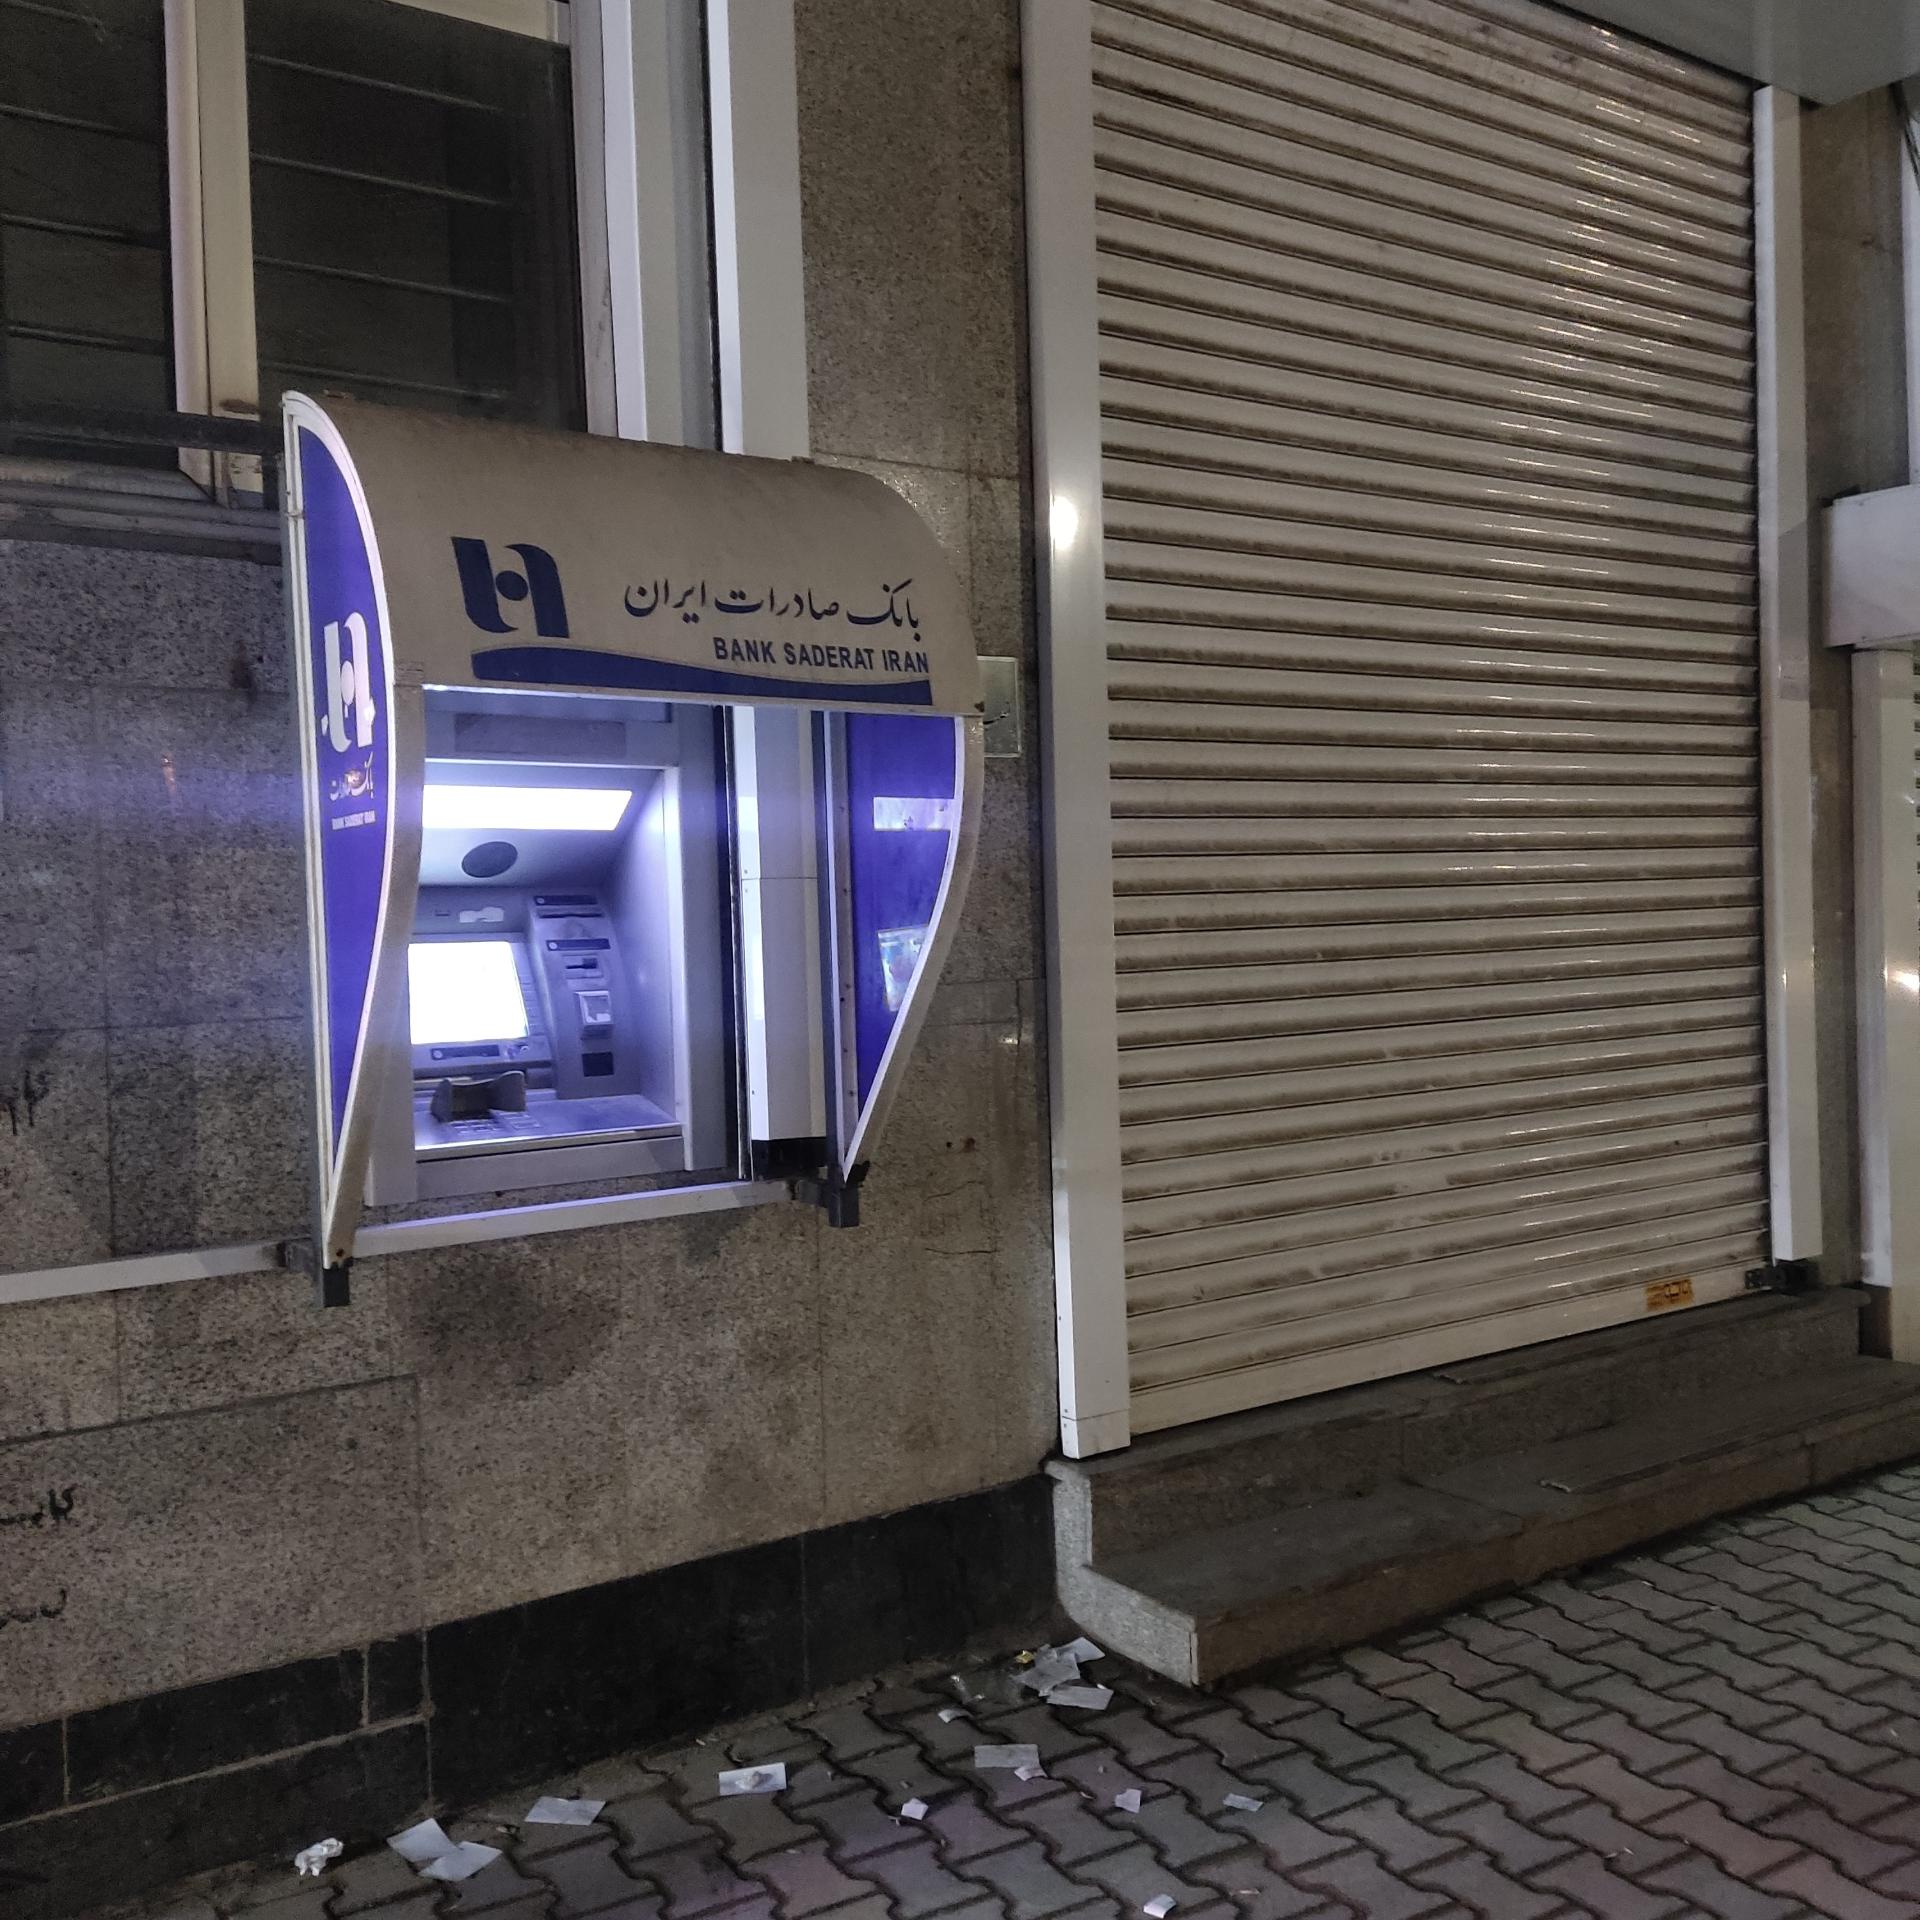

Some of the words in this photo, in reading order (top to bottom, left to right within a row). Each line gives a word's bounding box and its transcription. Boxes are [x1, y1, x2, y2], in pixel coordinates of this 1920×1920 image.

[624, 578, 706, 624] ایران
[714, 585, 840, 621] صادرات
[846, 578, 921, 642] بانک
[713, 637, 776, 665] BANK
[783, 641, 875, 670] SADERAT
[881, 649, 930, 673] IRAN
